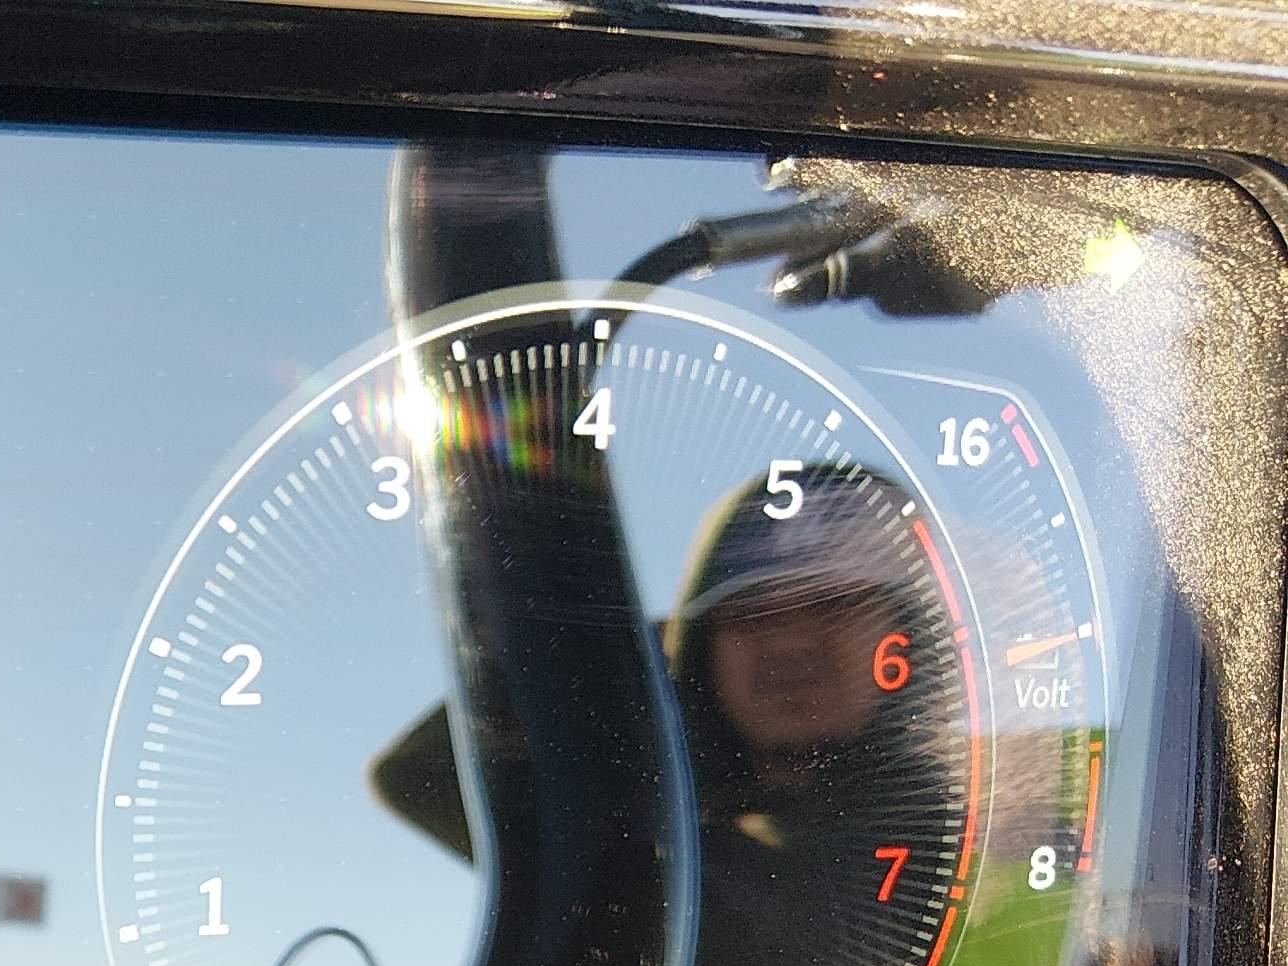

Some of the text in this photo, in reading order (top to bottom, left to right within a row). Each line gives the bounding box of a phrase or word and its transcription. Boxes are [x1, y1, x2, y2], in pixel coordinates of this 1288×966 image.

[572, 388, 616, 450] 4
[936, 417, 990, 467] 16
[365, 456, 411, 521] 3
[763, 459, 805, 521] 5
[219, 643, 264, 706] 2
[871, 632, 911, 692] 6
[1014, 678, 1071, 710] Volt
[873, 846, 911, 903] 7
[1028, 846, 1056, 890] 8
[198, 877, 230, 936] 1
